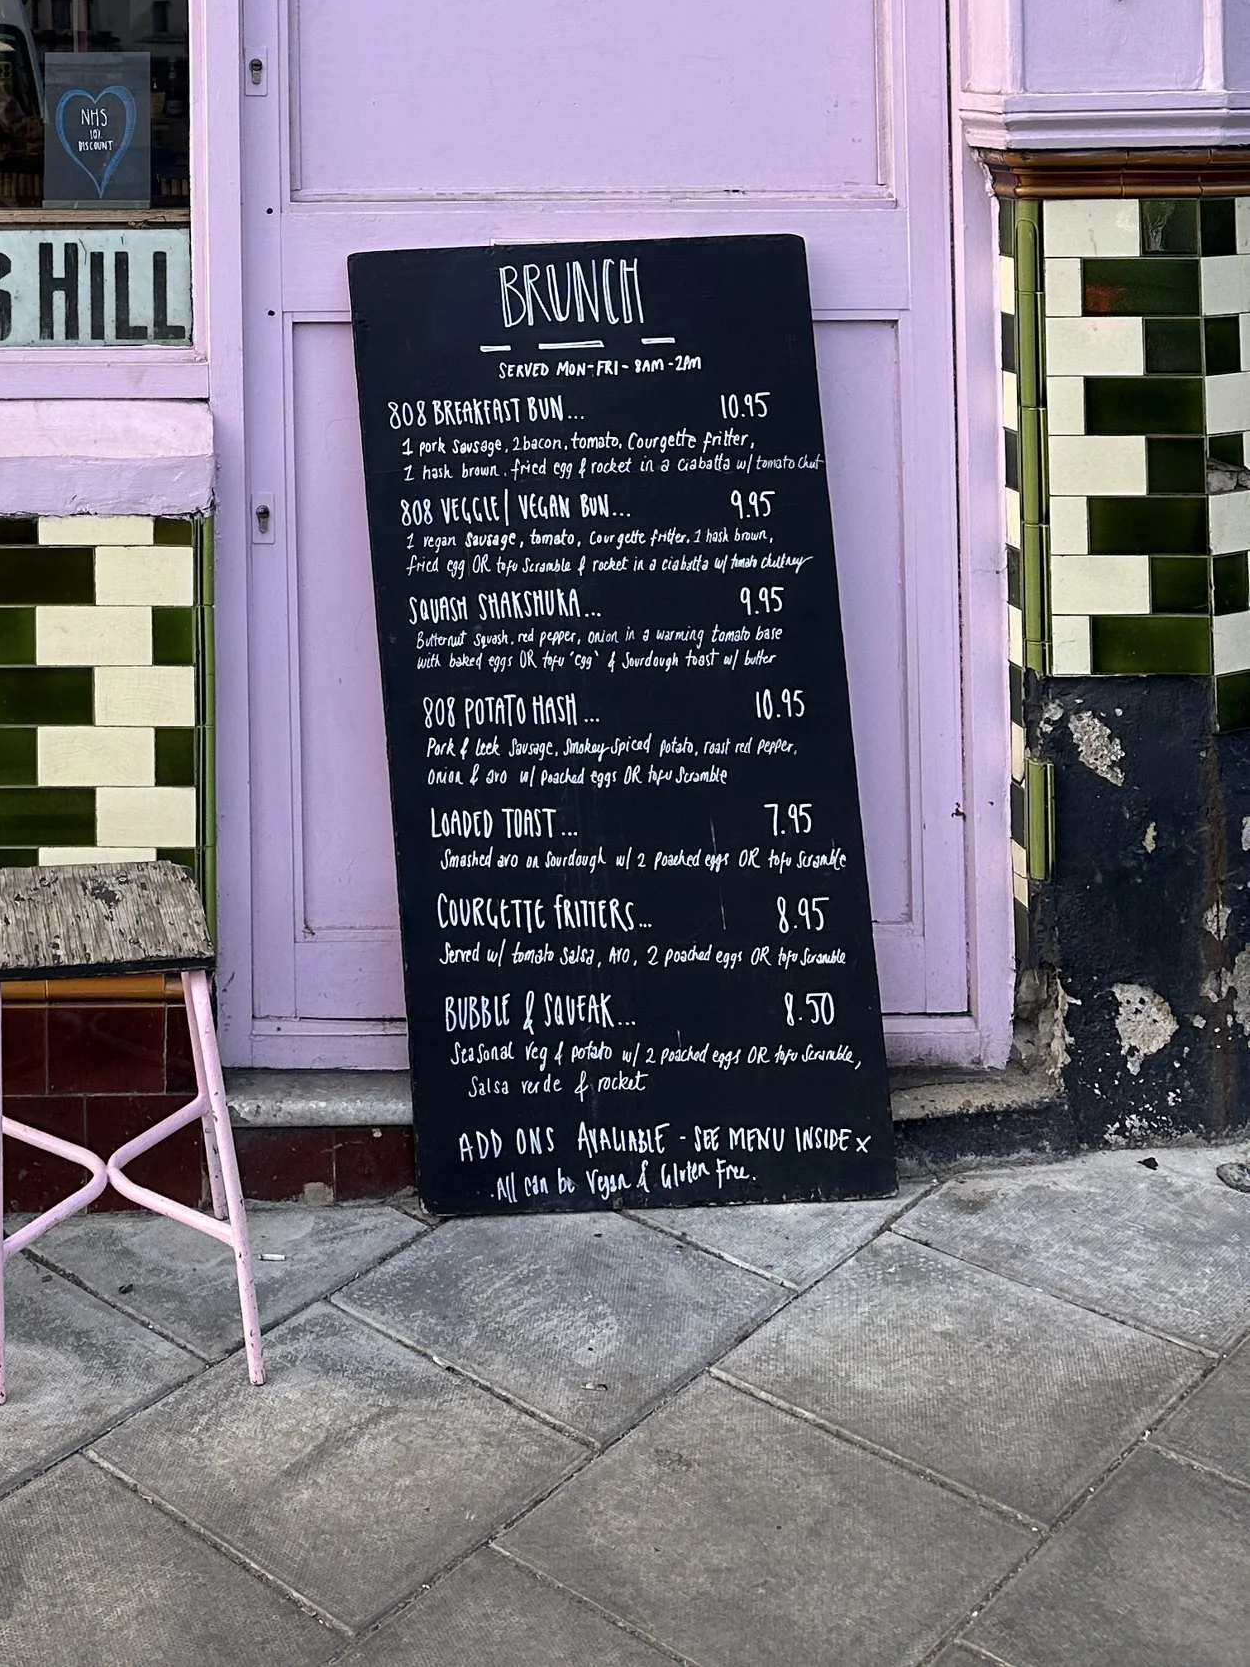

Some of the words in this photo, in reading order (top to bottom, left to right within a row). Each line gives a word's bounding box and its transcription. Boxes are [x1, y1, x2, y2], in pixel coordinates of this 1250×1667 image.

[81, 108, 108, 127] NHS
[78, 140, 114, 152] DISCOUNT
[38, 242, 187, 342] HILL
[499, 258, 644, 327] BRUNCH
[499, 362, 549, 379] SERVED
[388, 401, 426, 429] 808
[432, 398, 520, 425] BREAKFAST
[721, 392, 770, 419] 10.95
[640, 455, 654, 472] in
[401, 499, 433, 526] 808
[518, 493, 570, 519] VEGAN
[731, 490, 775, 519] 9.95
[473, 554, 491, 573] OR
[633, 556, 644, 571] in
[409, 596, 468, 625] SQUASH
[740, 587, 784, 615] 9.95
[625, 626, 635, 641] in
[520, 649, 537, 668] OR
[423, 697, 455, 728] 808
[465, 694, 526, 729] POTATO
[756, 689, 804, 720] 10.95
[624, 765, 642, 784] OR
[431, 808, 493, 838] LOADED
[764, 804, 812, 836] 7.95
[637, 853, 646, 867] 2
[739, 847, 760, 868] OR
[438, 893, 545, 933] COURGETTE
[777, 897, 829, 933] 8.95
[647, 946, 658, 965] 2
[751, 946, 771, 966] OR
[446, 993, 510, 1031] BUBBLE
[785, 992, 834, 1026] 8.50
[646, 1048, 656, 1063] 2
[748, 1046, 770, 1064] OR
[459, 1129, 502, 1161] ADD
[517, 1127, 554, 1154] ONS
[695, 1126, 720, 1152] SEE
[729, 1127, 785, 1152] MENU
[795, 1126, 852, 1152] INSIDE
